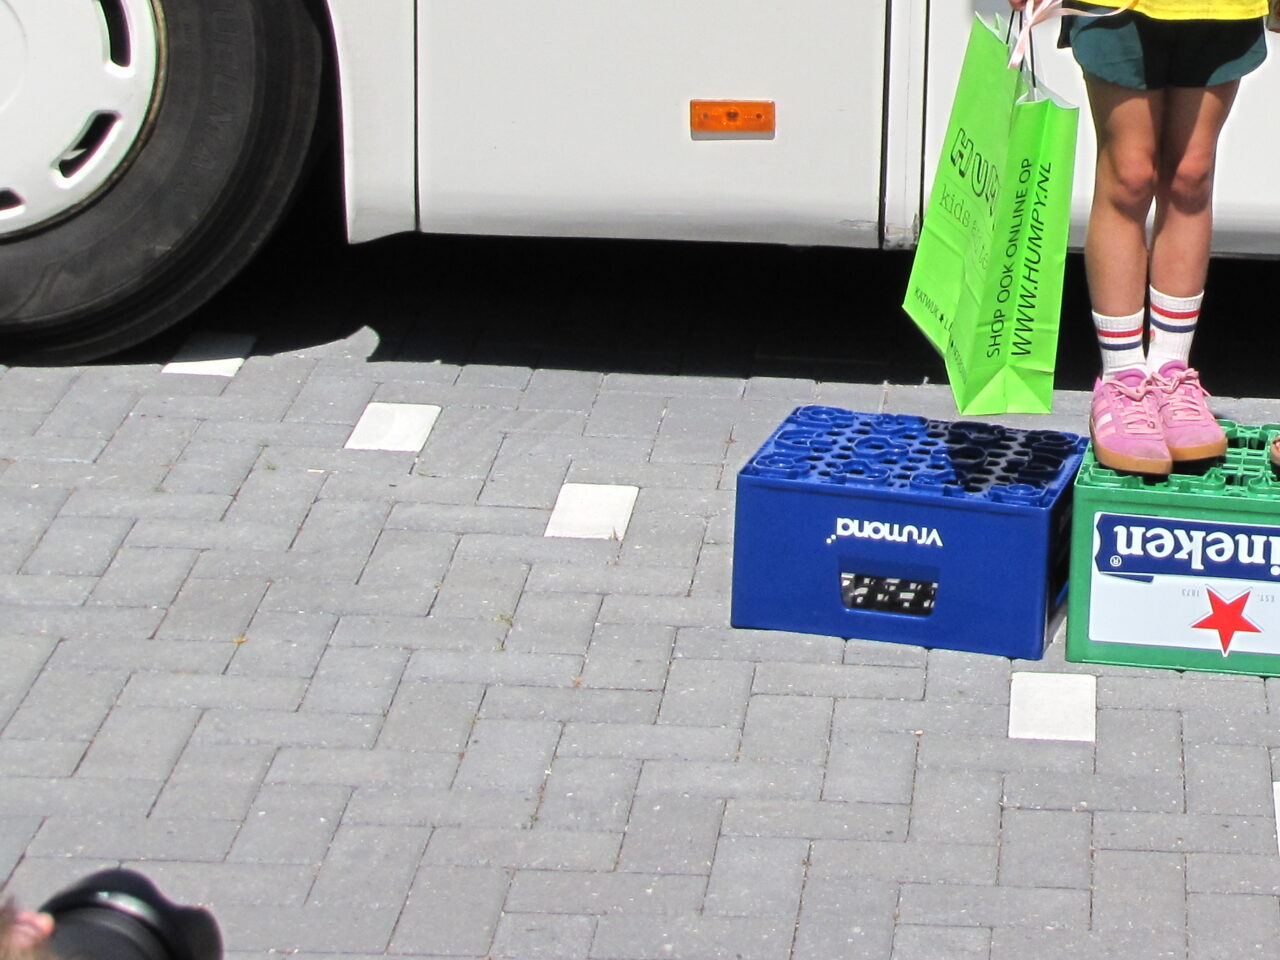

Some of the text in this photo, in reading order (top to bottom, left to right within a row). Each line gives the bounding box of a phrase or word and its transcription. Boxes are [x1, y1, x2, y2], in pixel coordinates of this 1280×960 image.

[939, 183, 971, 228] kids
[986, 158, 1033, 359] SHOP OOK ONLINE OP
[1011, 162, 1052, 356] WWW.HUMPY.NL
[836, 517, 944, 547] vrumona
